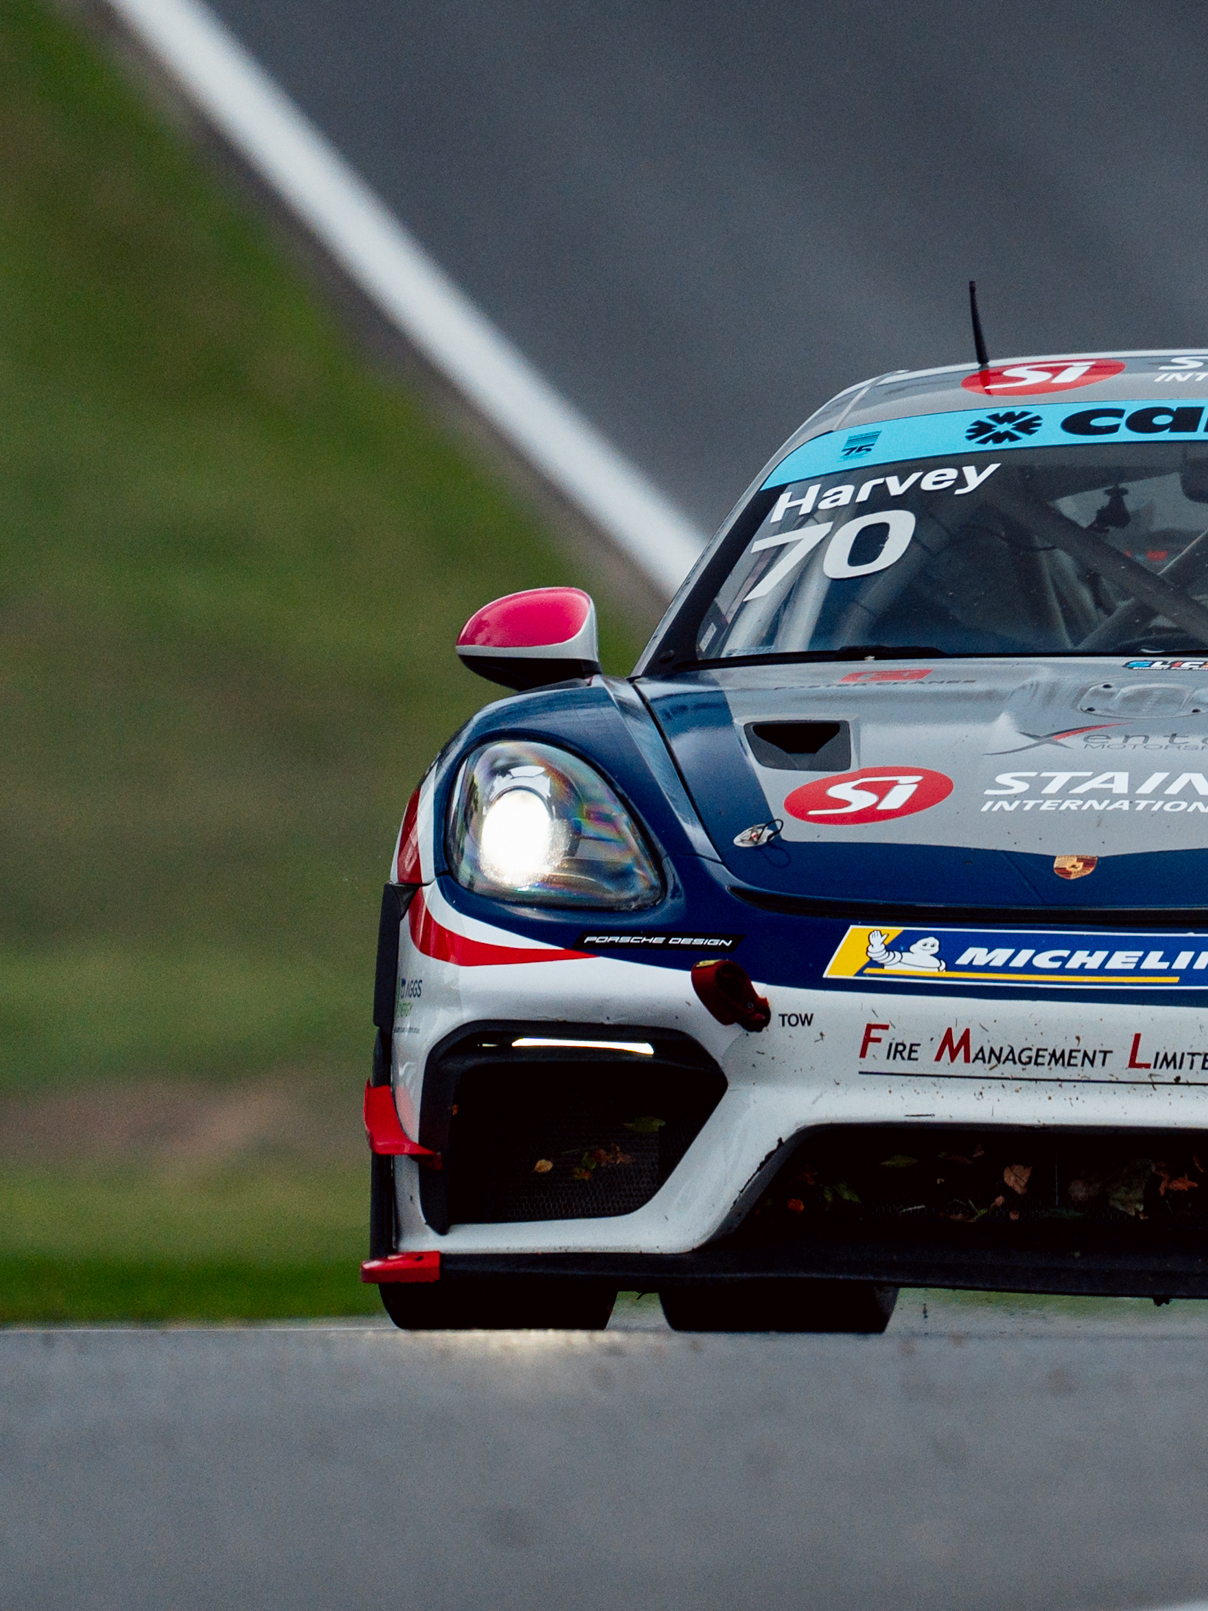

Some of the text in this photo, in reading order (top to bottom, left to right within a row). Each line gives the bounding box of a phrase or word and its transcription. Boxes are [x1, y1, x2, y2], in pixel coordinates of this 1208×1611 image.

[769, 463, 1002, 523] Harvey
[743, 509, 916, 602] 70
[584, 935, 733, 947] PORSCHE DESIGN
[778, 1012, 814, 1028] TOW
